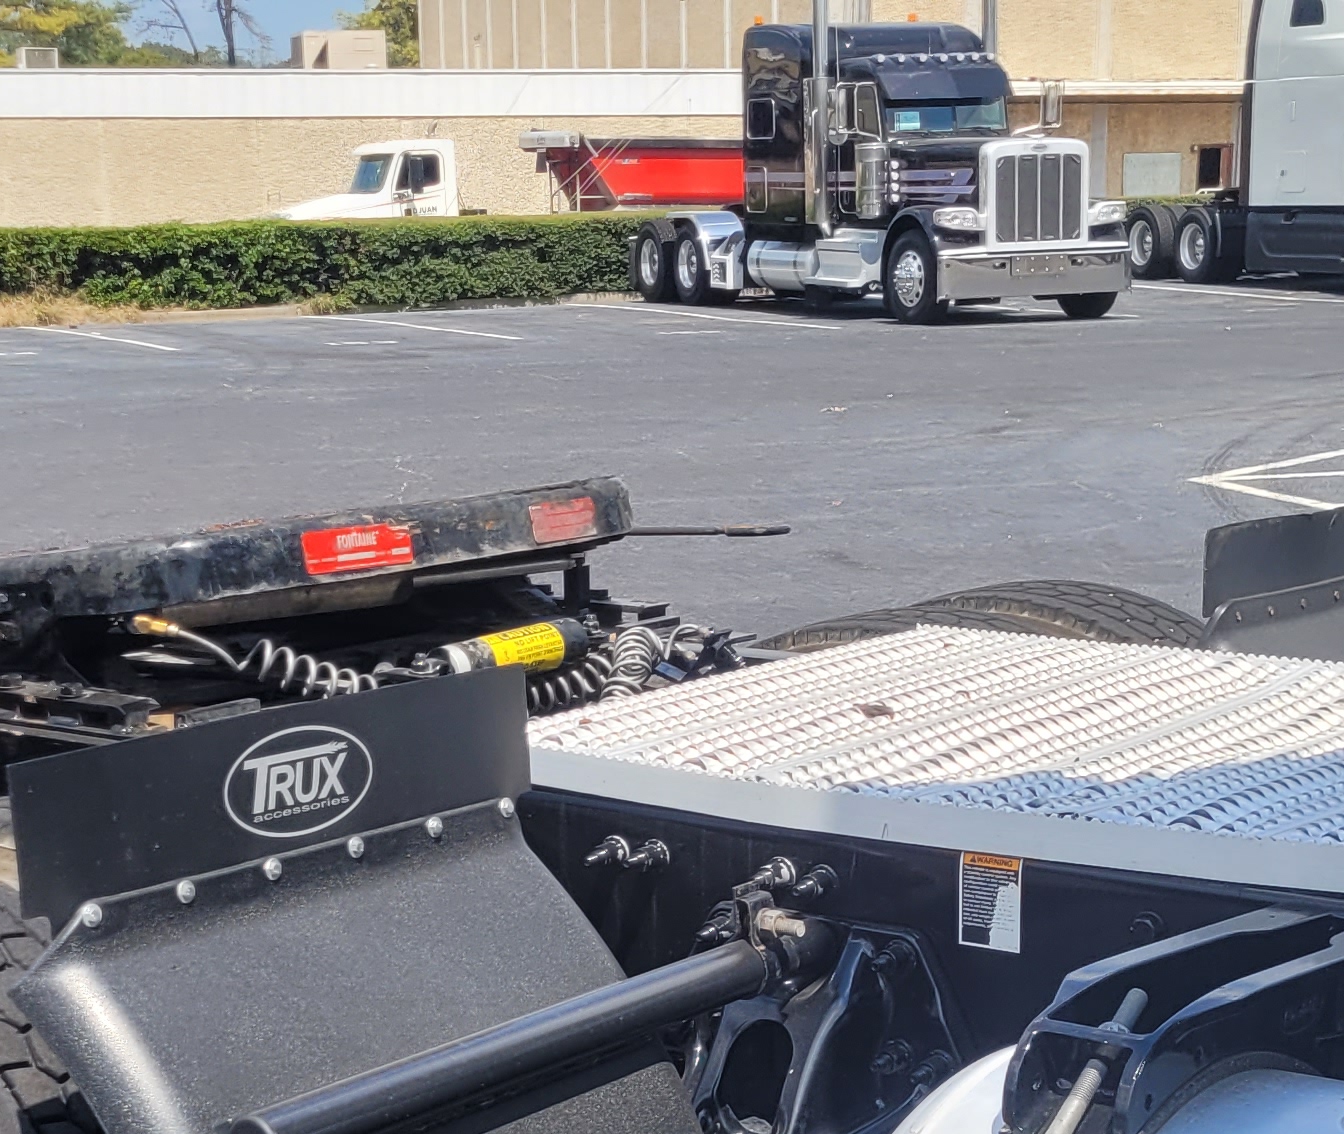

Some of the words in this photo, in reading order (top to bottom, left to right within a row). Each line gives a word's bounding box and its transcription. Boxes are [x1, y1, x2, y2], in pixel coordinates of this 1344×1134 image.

[336, 531, 377, 550] FONTAINE
[497, 623, 552, 640] CAUTION
[243, 741, 348, 815] TRUX
[253, 795, 350, 823] accessories
